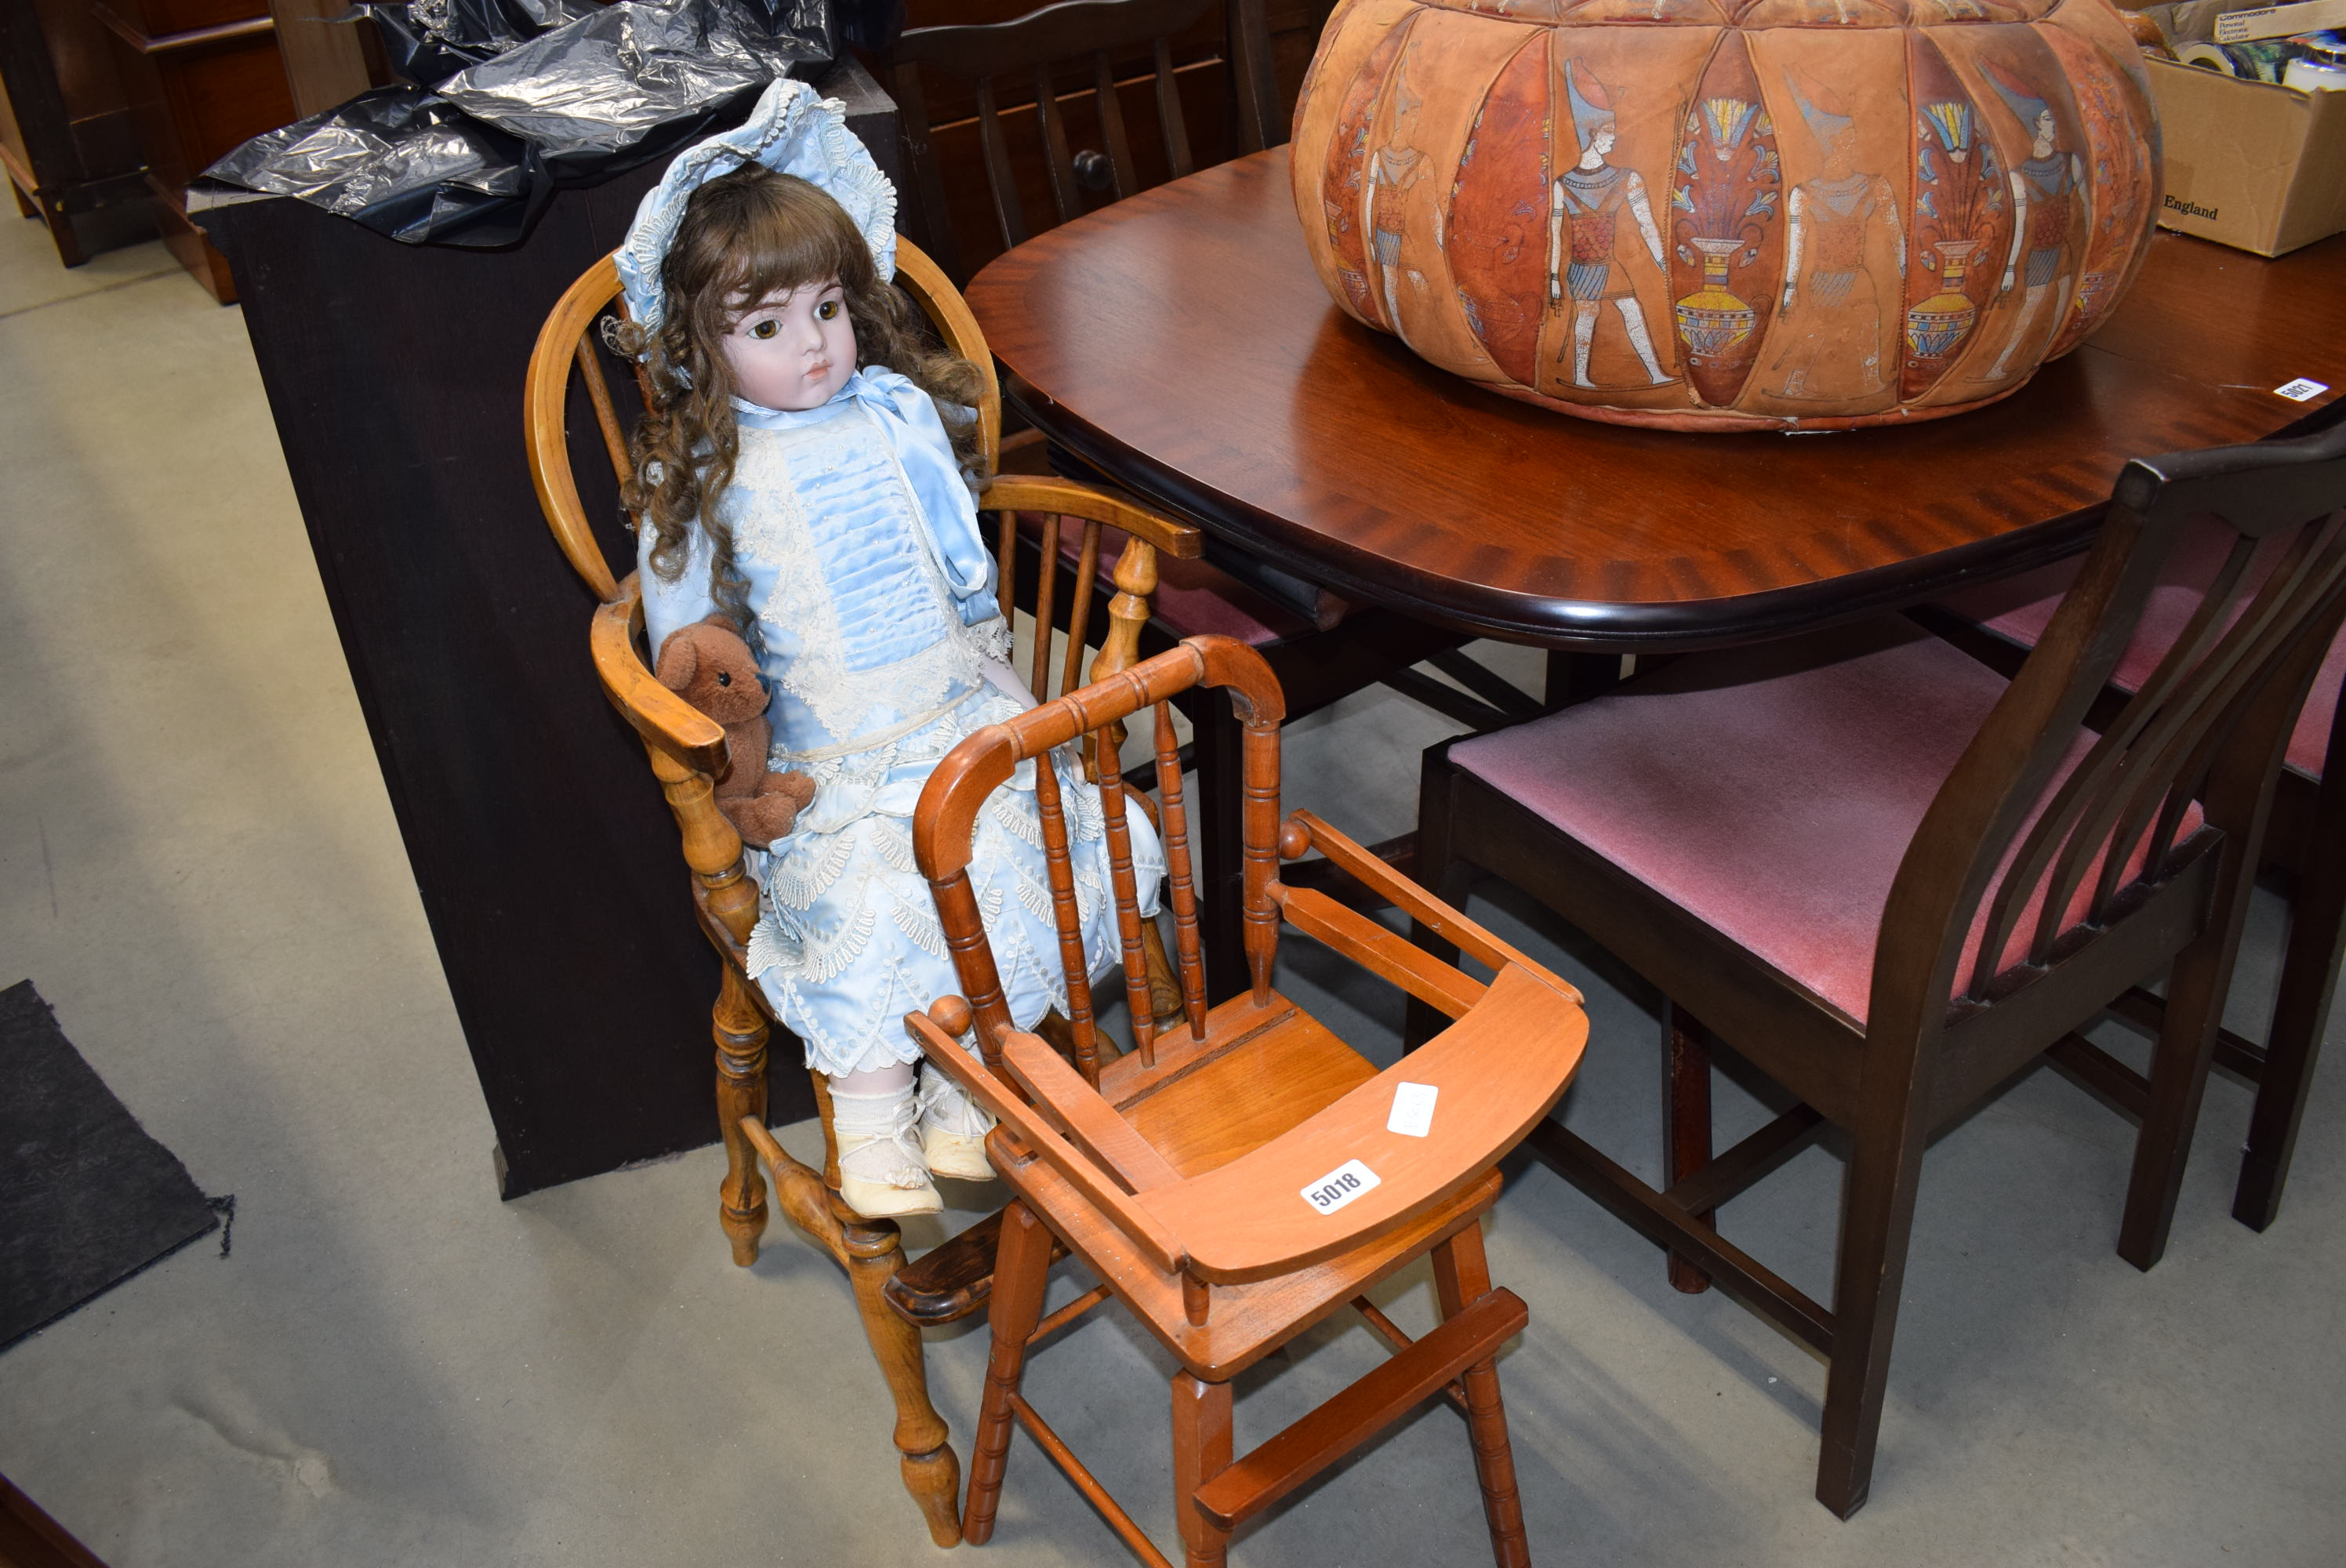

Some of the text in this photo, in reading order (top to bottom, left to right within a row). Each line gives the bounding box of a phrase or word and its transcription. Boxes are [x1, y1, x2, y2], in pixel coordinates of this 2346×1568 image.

[2220, 9, 2276, 21] Commodore
[2220, 20, 2245, 28] Personal
[2219, 27, 2248, 35] Electronic
[2164, 194, 2218, 220] England
[2281, 383, 2313, 397] 5021
[1310, 1173, 1361, 1207] 5018
